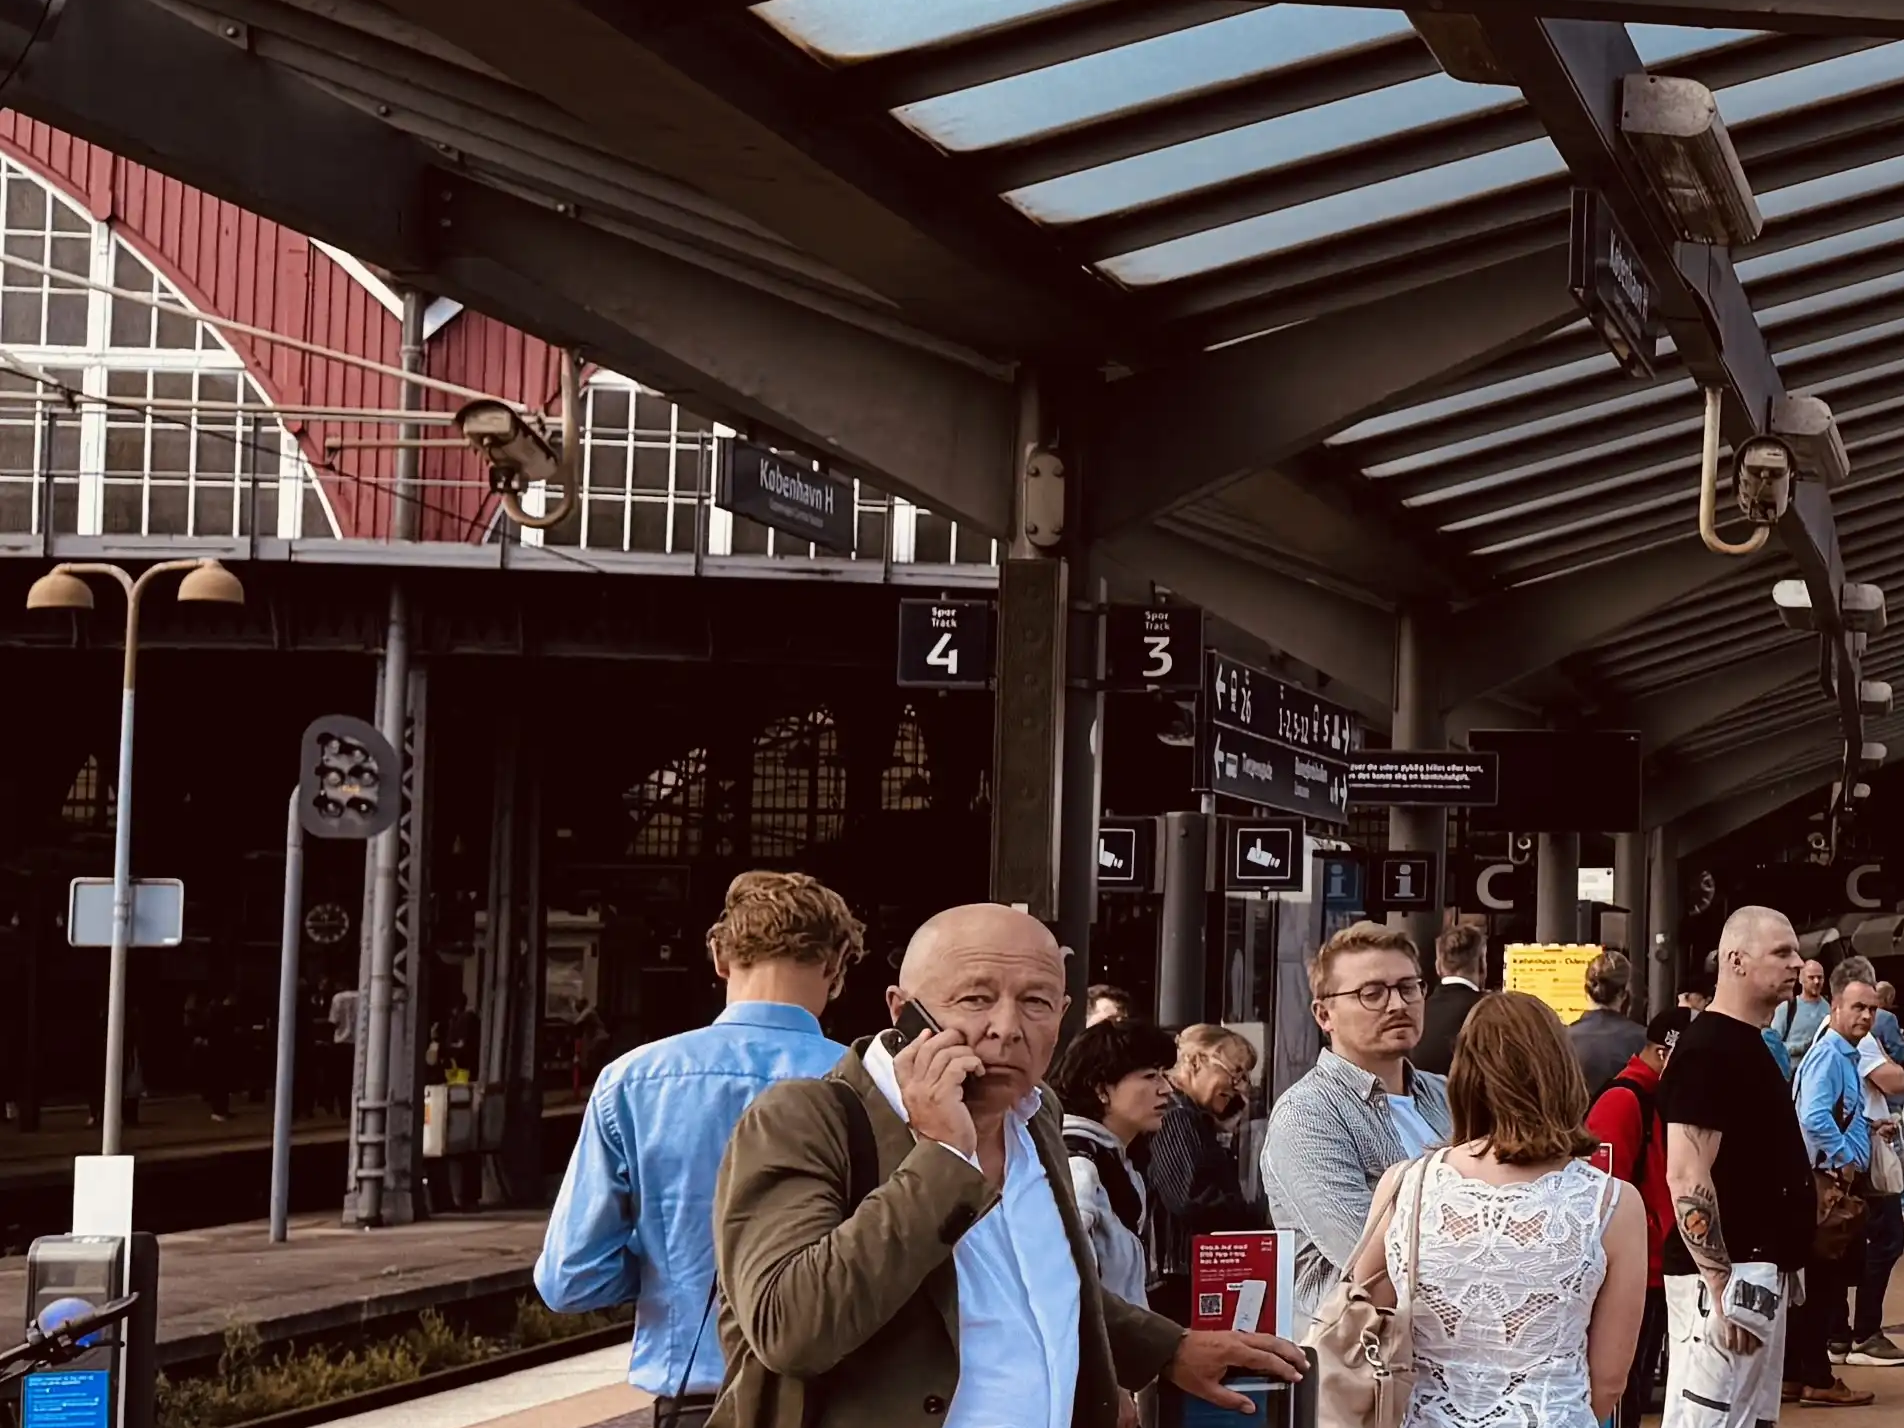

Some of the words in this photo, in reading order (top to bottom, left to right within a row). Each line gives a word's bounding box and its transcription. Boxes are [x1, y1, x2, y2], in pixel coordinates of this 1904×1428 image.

[825, 484, 834, 515] H
[931, 607, 957, 619] Spor
[931, 617, 958, 628] Track
[1145, 611, 1169, 622] Spor
[1145, 621, 1170, 631] Track
[926, 632, 959, 675] 4
[1142, 636, 1173, 677] 3
[1240, 687, 1251, 724] 26
[1476, 864, 1514, 909] C
[1846, 864, 1881, 908] C
